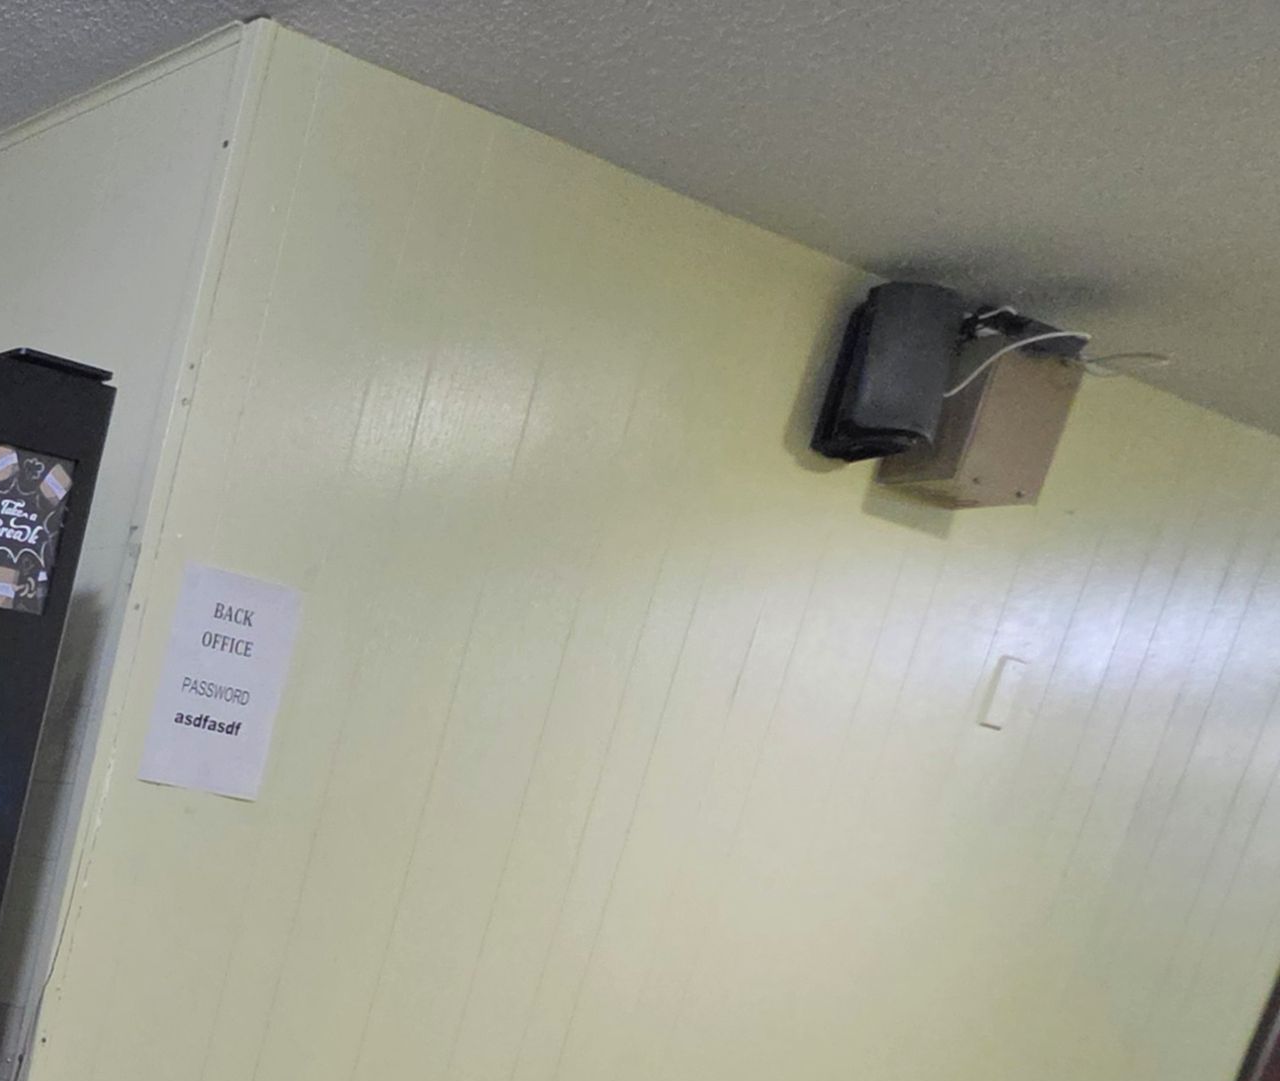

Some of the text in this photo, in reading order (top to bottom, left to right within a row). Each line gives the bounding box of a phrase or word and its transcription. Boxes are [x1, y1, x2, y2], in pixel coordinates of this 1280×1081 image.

[1, 499, 28, 518] Take
[213, 602, 254, 627] BACK
[201, 631, 254, 658] OFFICE
[181, 676, 250, 706] PASSWORD
[174, 711, 242, 736] asdfasdf
